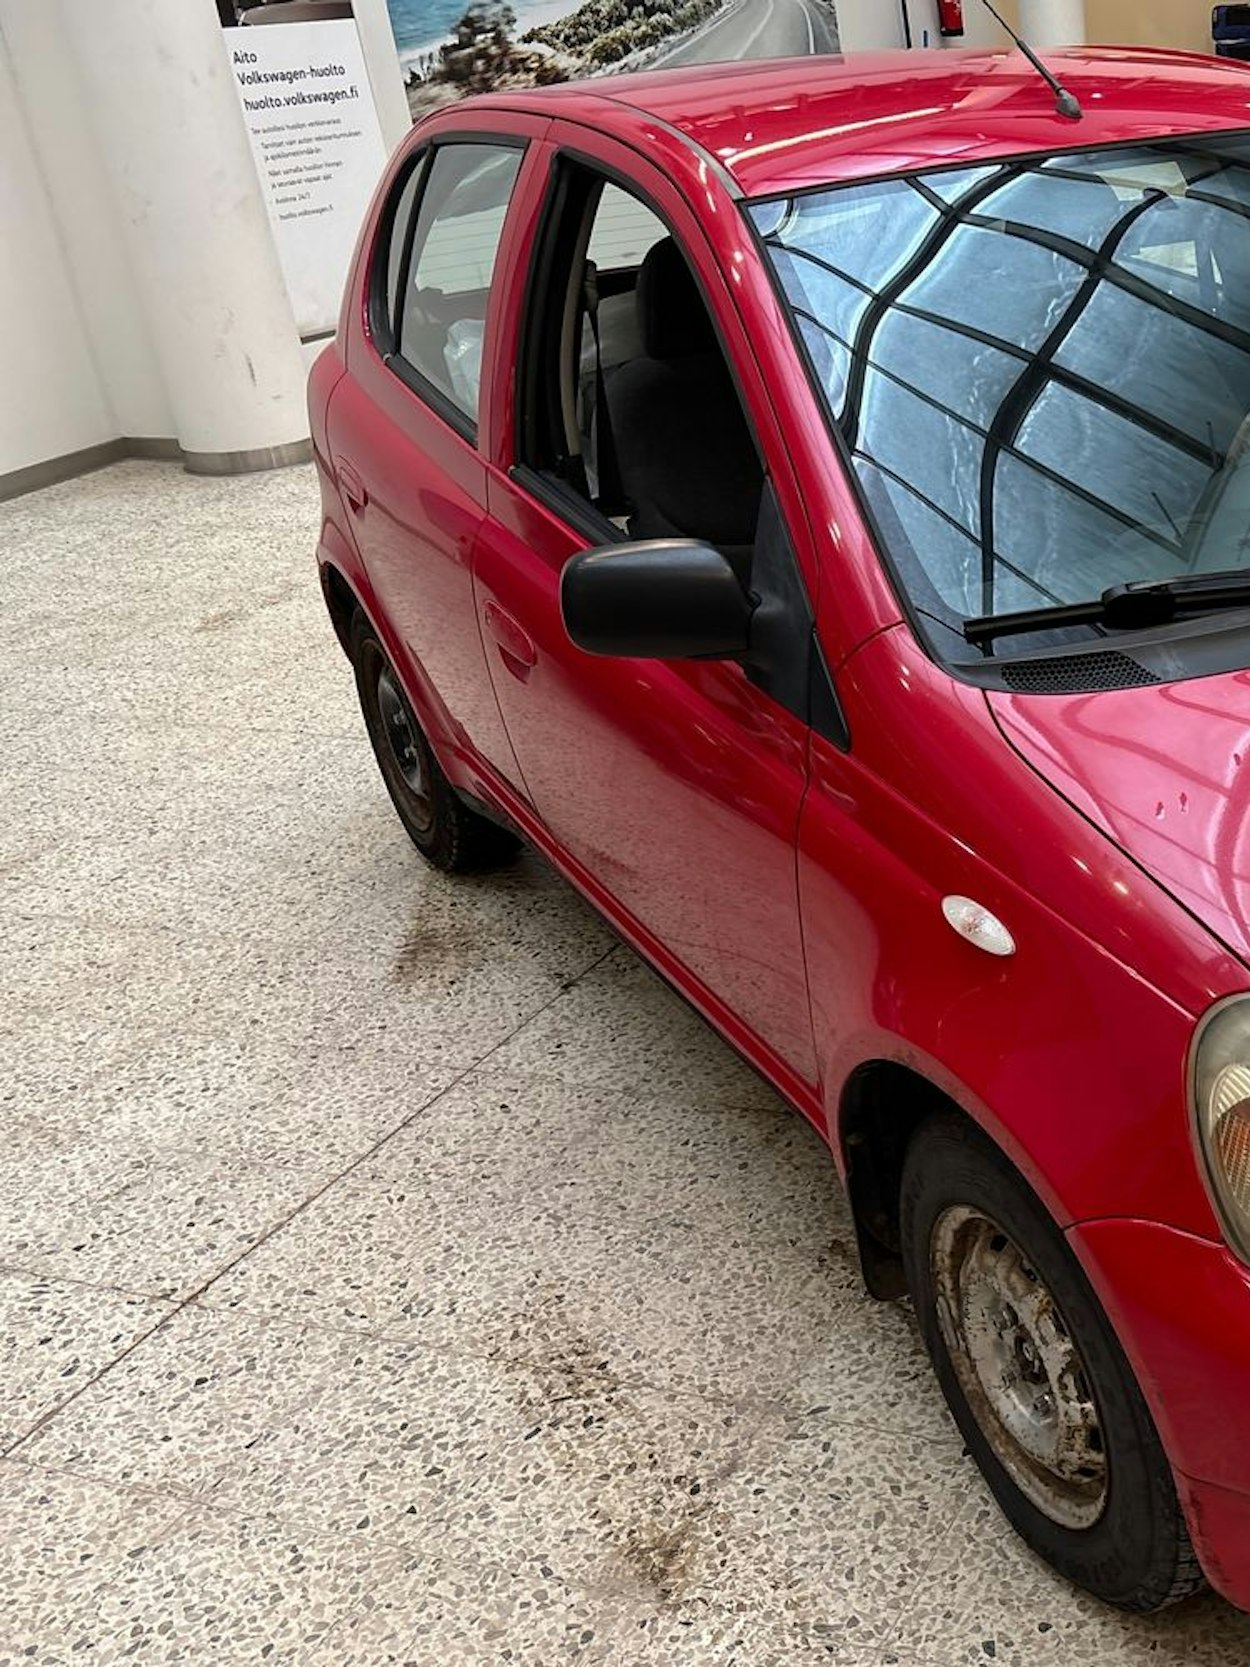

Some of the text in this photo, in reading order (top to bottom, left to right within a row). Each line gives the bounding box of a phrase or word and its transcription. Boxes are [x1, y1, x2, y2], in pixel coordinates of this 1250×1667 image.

[233, 50, 258, 64] Aito
[237, 64, 345, 85] Volkswagen-huolto
[243, 85, 359, 111] huolto.volkswagen.fi
